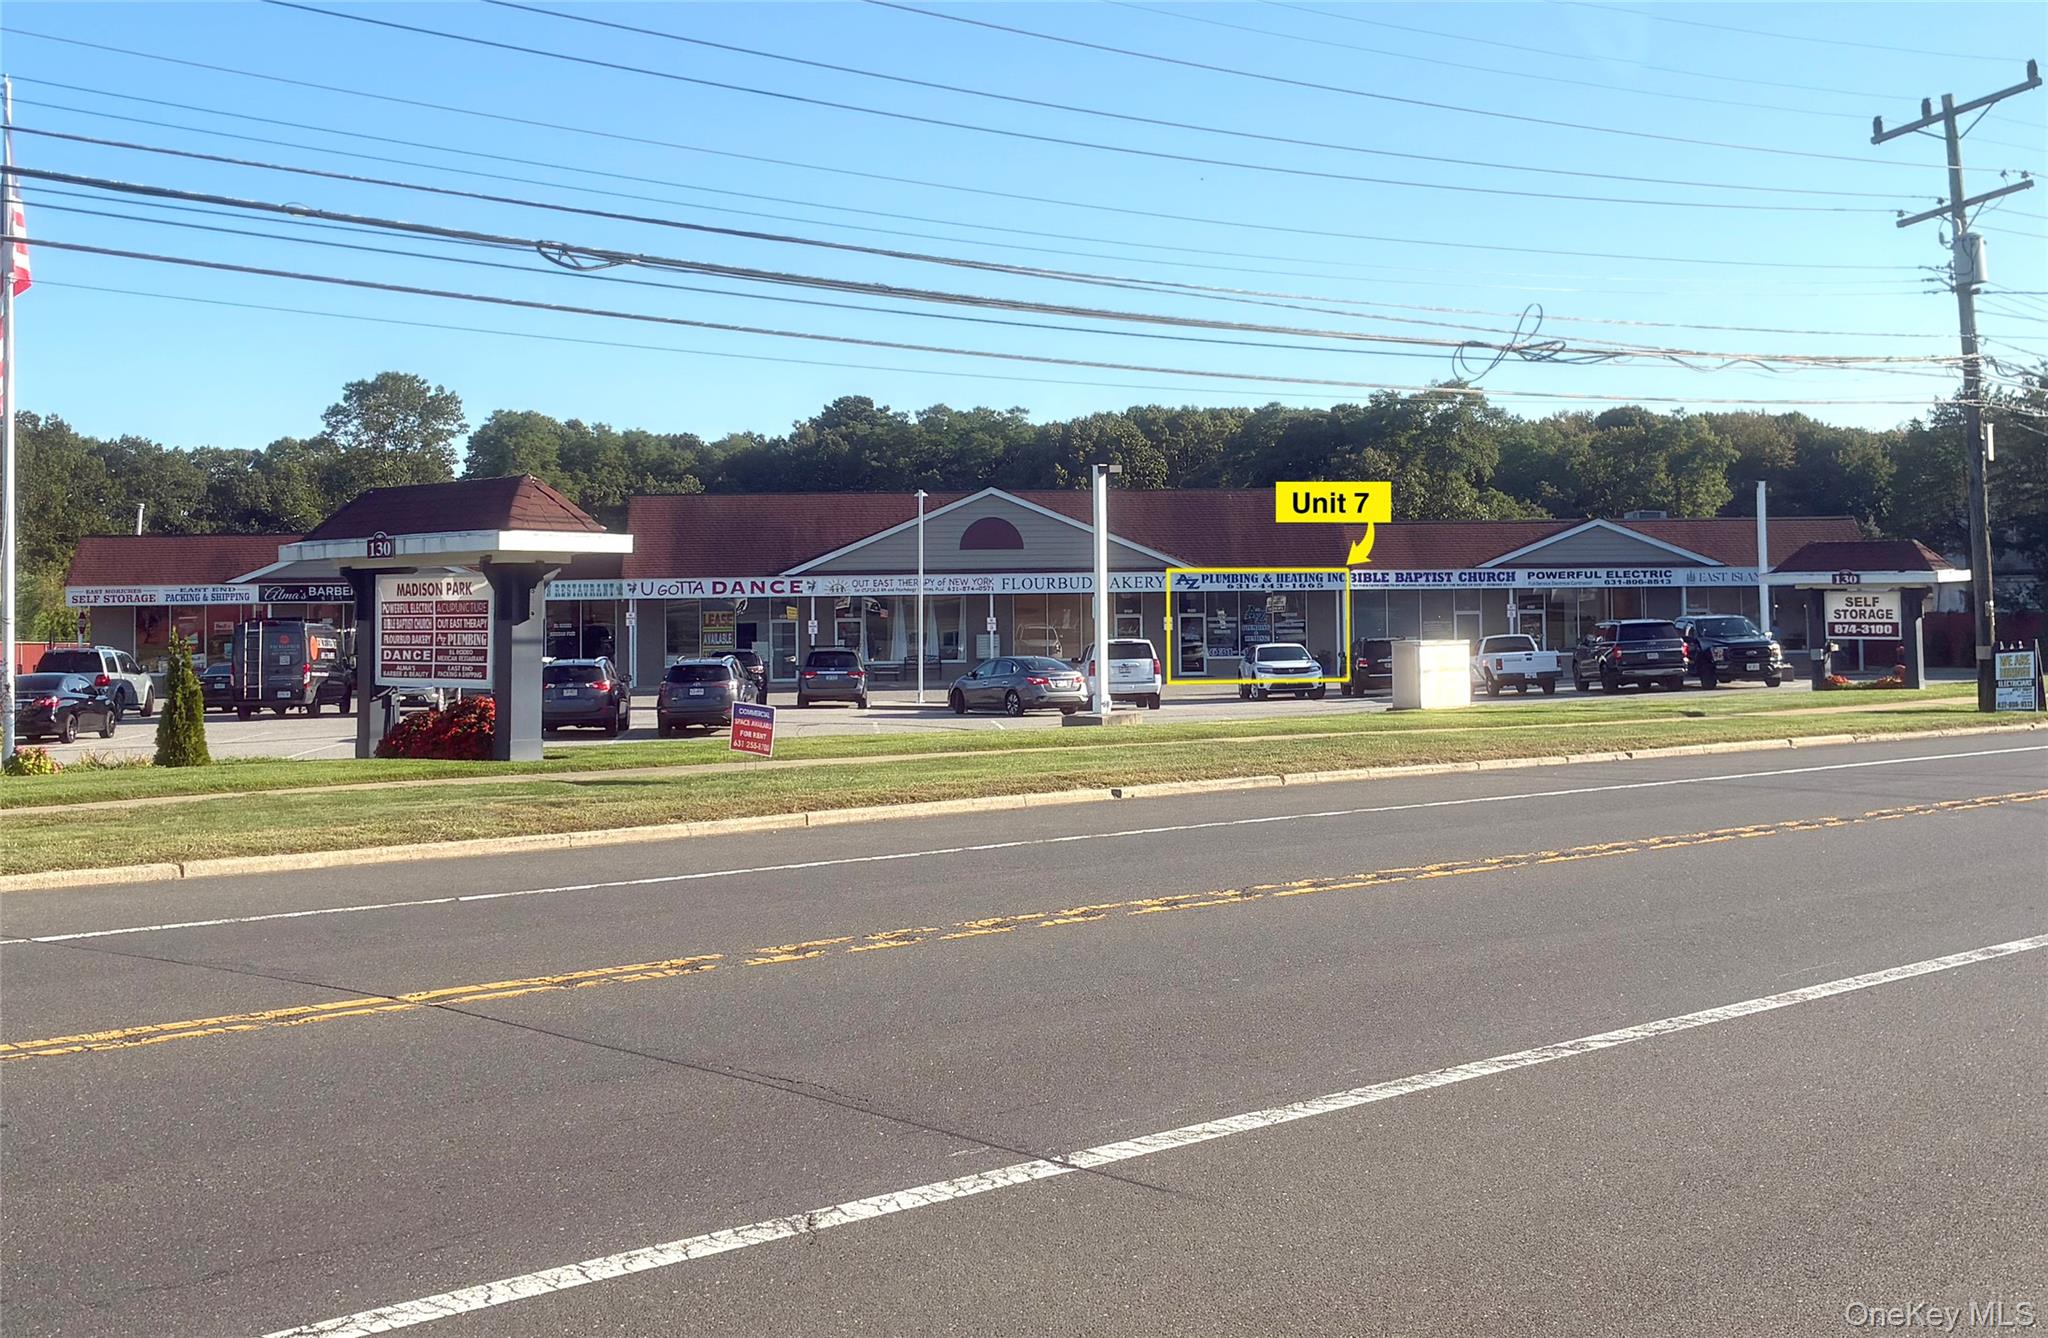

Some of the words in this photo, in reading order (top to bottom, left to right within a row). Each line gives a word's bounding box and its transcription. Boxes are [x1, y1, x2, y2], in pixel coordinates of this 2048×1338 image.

[369, 541, 391, 557] 130
[1201, 573, 1259, 584] PLUMBING
[1262, 573, 1273, 583] &
[1276, 572, 1324, 583] HEATING
[1350, 572, 1390, 583] BIBLE
[1395, 572, 1452, 583] BAPTIST
[1458, 571, 1517, 582] CHURCH
[1527, 571, 1602, 580] POWERFUL
[1606, 569, 1673, 579] ELECTRIC
[1699, 572, 1727, 582] EAST
[1834, 575, 1858, 584] 130
[641, 581, 654, 596] U
[657, 580, 705, 596] GOTTA
[712, 580, 803, 595] DANCE
[852, 580, 869, 588] OUT
[873, 579, 893, 588] EAST
[898, 578, 935, 588] THERPY
[938, 578, 947, 587] of
[949, 578, 969, 587] NEW
[972, 577, 994, 587] YORK
[1002, 577, 1093, 590] FLOURBUD
[1109, 576, 1166, 589] AKERY
[1226, 582, 1324, 590] 631-443-1665
[308, 586, 353, 596] BARBE
[396, 582, 442, 597] MADISON
[446, 581, 472, 596] PARK
[555, 583, 615, 598] RESTAURANT
[71, 594, 101, 604] SELF
[103, 594, 157, 603] STORAGE
[165, 593, 201, 602] PACKING
[203, 593, 209, 601] &
[210, 592, 250, 601] SHIPPING
[1845, 596, 1880, 608] SELF
[382, 603, 409, 614] POWERFUL
[410, 602, 433, 614] ELECTRIC
[437, 602, 487, 613] ACUPUNCTURE
[703, 612, 734, 625] LEASE
[1833, 609, 1894, 620] STORAGE
[437, 619, 449, 629] OUT
[450, 619, 463, 628] EAST
[464, 618, 487, 629] THERAPY
[1834, 624, 1893, 635] 874-3100
[411, 634, 431, 645] BAKERY
[447, 633, 487, 646] PLUMBING
[383, 650, 431, 660] DANCE
[740, 730, 752, 738] FOR
[733, 739, 745, 748] 631
